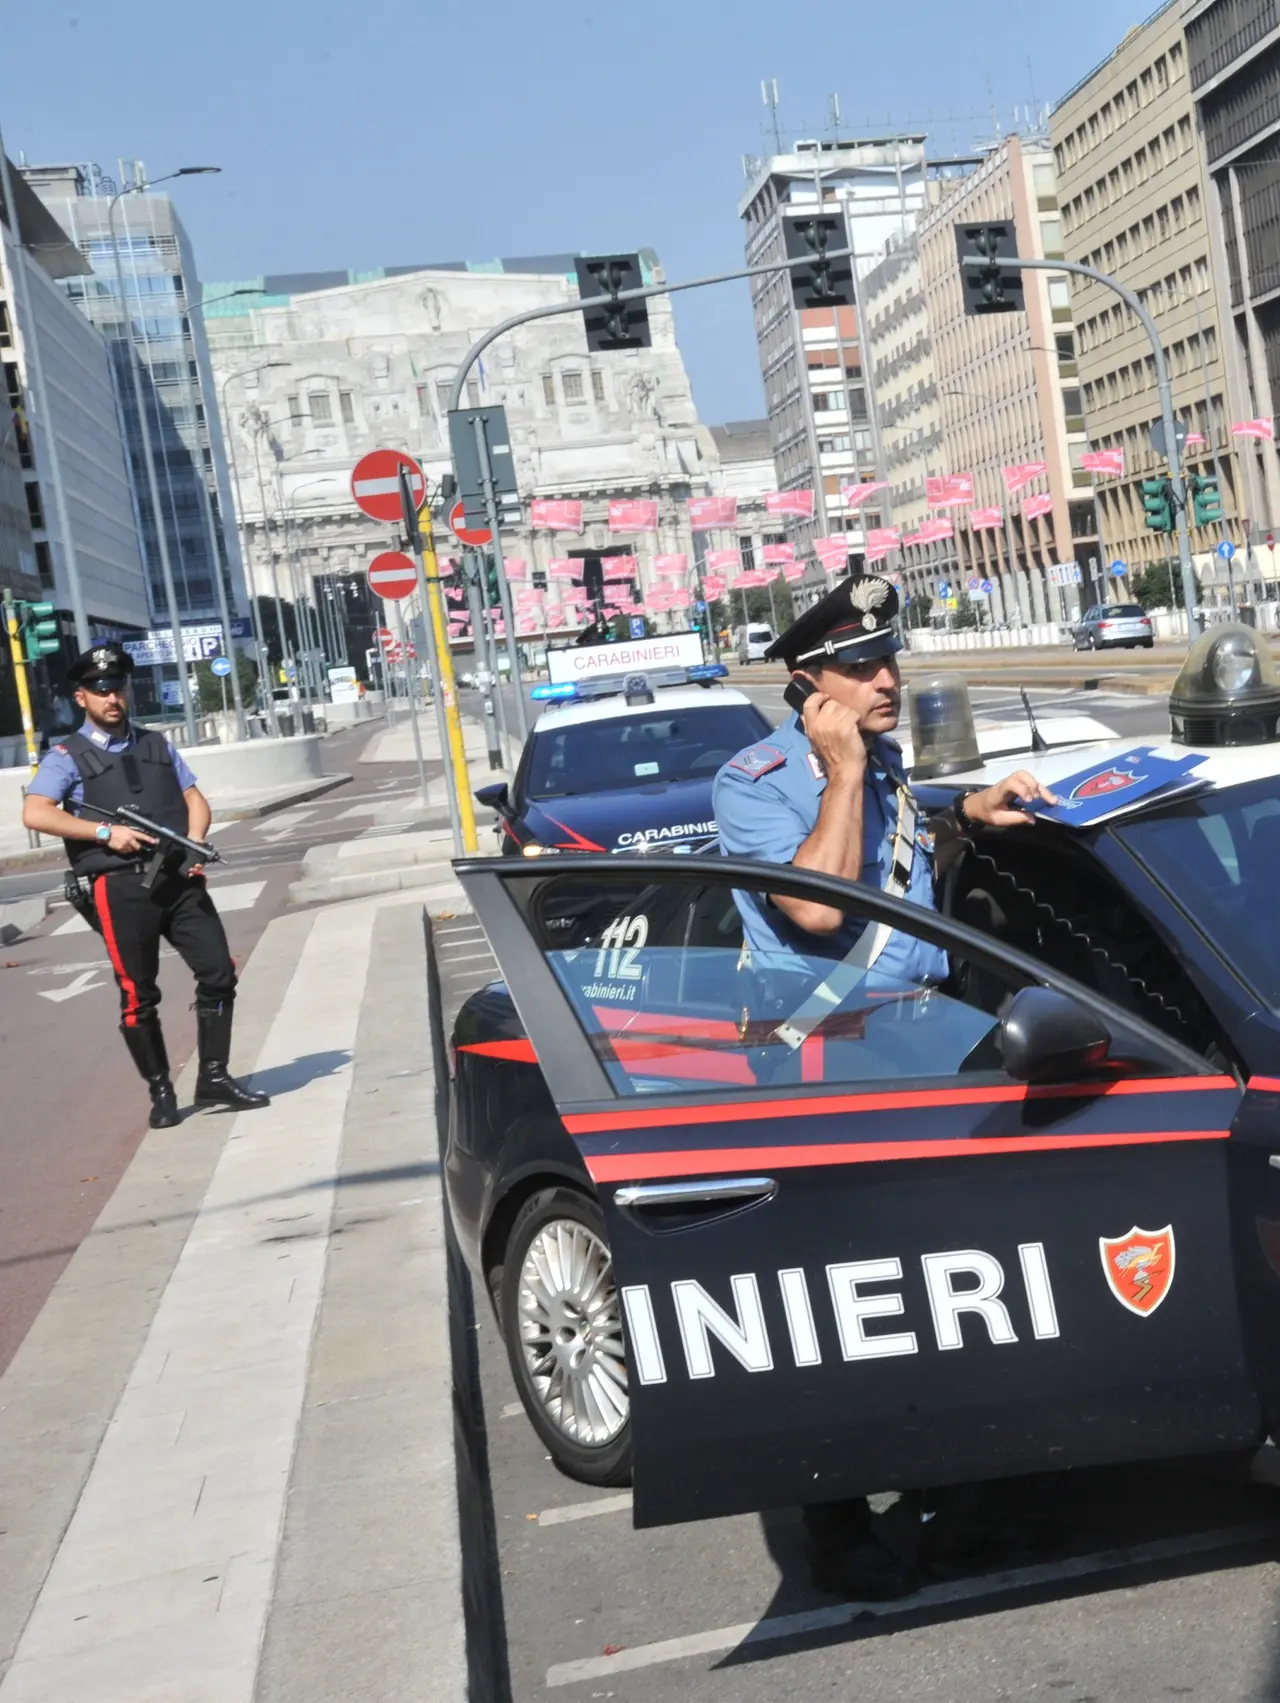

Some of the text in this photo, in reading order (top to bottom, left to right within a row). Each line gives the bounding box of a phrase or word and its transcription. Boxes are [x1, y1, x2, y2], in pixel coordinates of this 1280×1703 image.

[202, 637, 218, 657] P
[573, 644, 680, 671] CARABINIERI
[593, 914, 649, 980] 112
[621, 1241, 1060, 1386] INIERI
